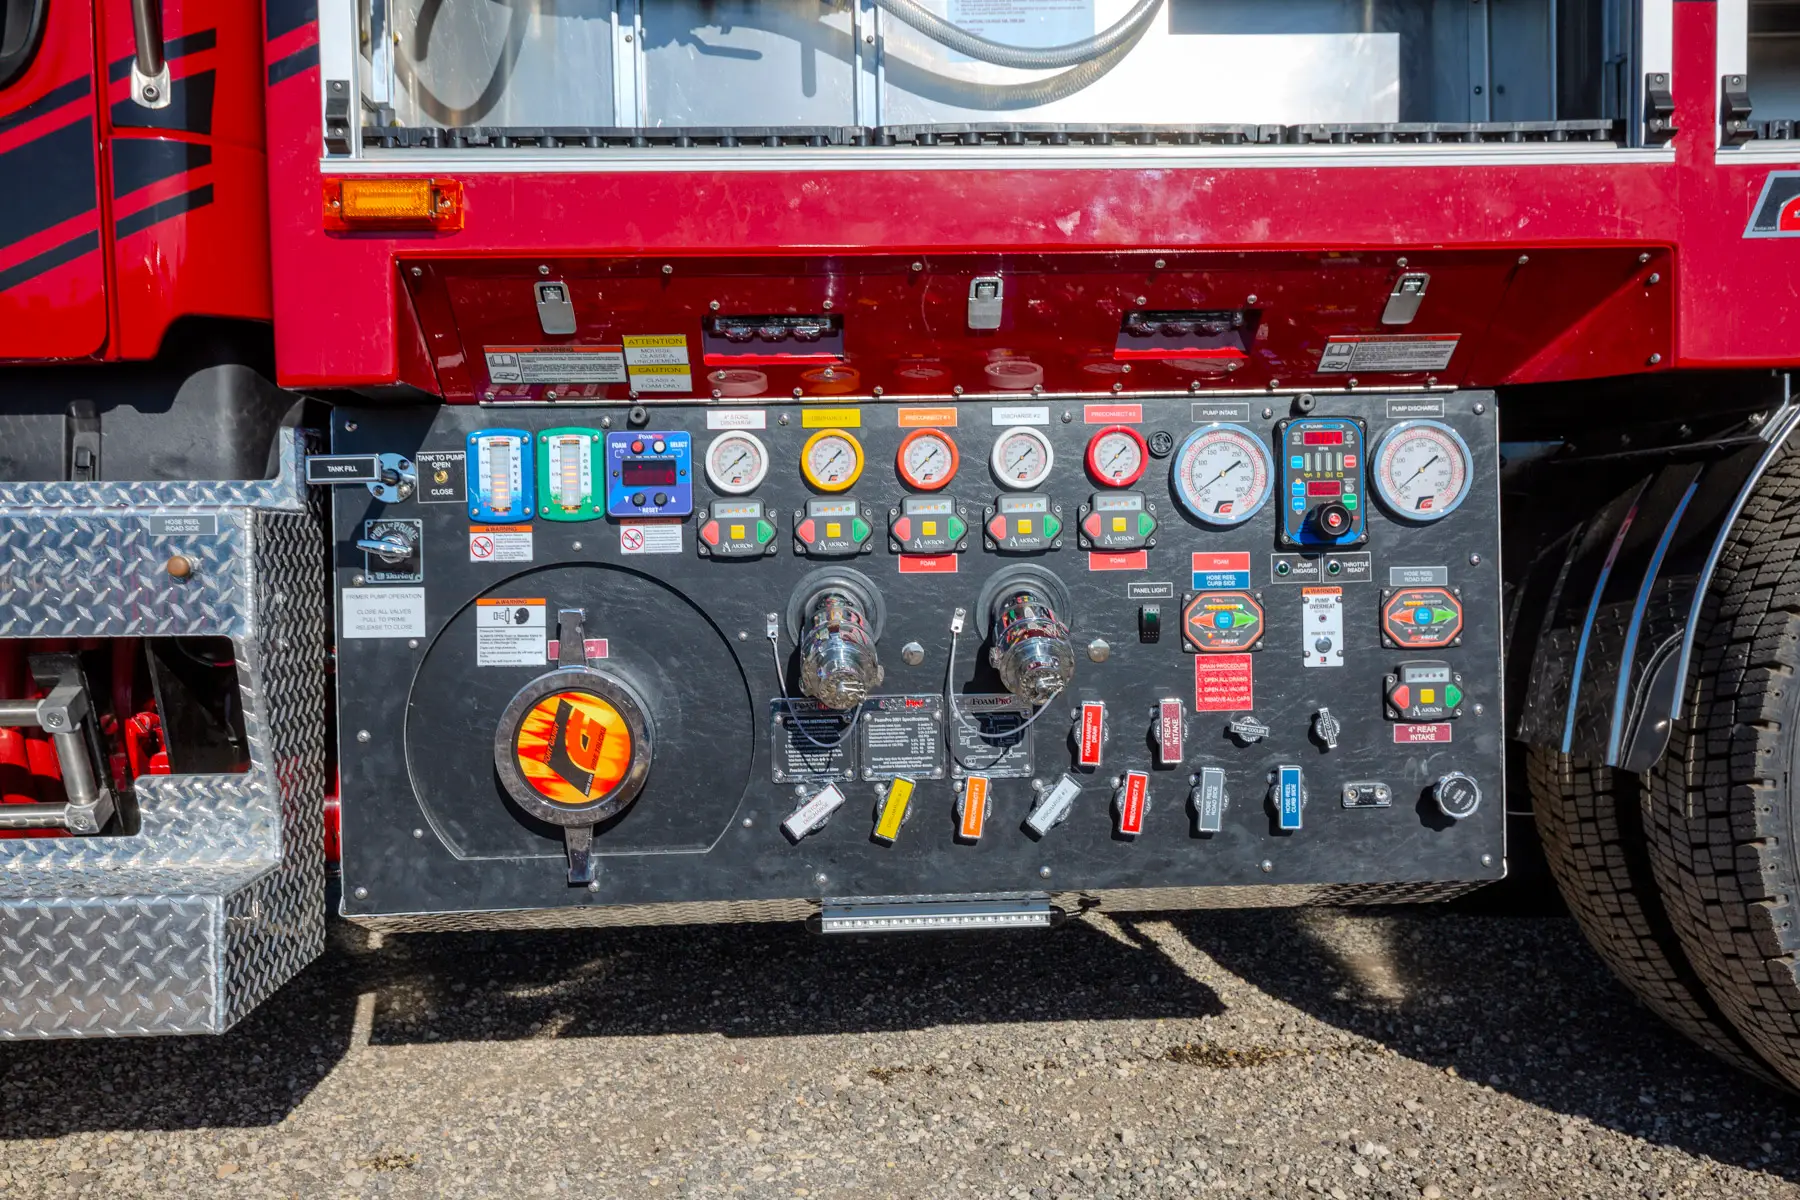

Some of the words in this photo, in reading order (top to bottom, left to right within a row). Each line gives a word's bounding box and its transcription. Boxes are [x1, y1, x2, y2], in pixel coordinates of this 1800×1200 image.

[418, 454, 436, 462] TANK
[370, 523, 389, 541] PULL
[393, 521, 419, 542] PRIME
[386, 572, 415, 580] Darley
[543, 745, 552, 765] FORT
[549, 721, 559, 746] GARRY
[596, 727, 607, 755] TRUCKS
[1410, 733, 1435, 741] INTAKE
[969, 792, 980, 830] PRECONNECT
[1040, 795, 1062, 822] DISCHARGE
[1128, 789, 1139, 826] PRECONNECT
